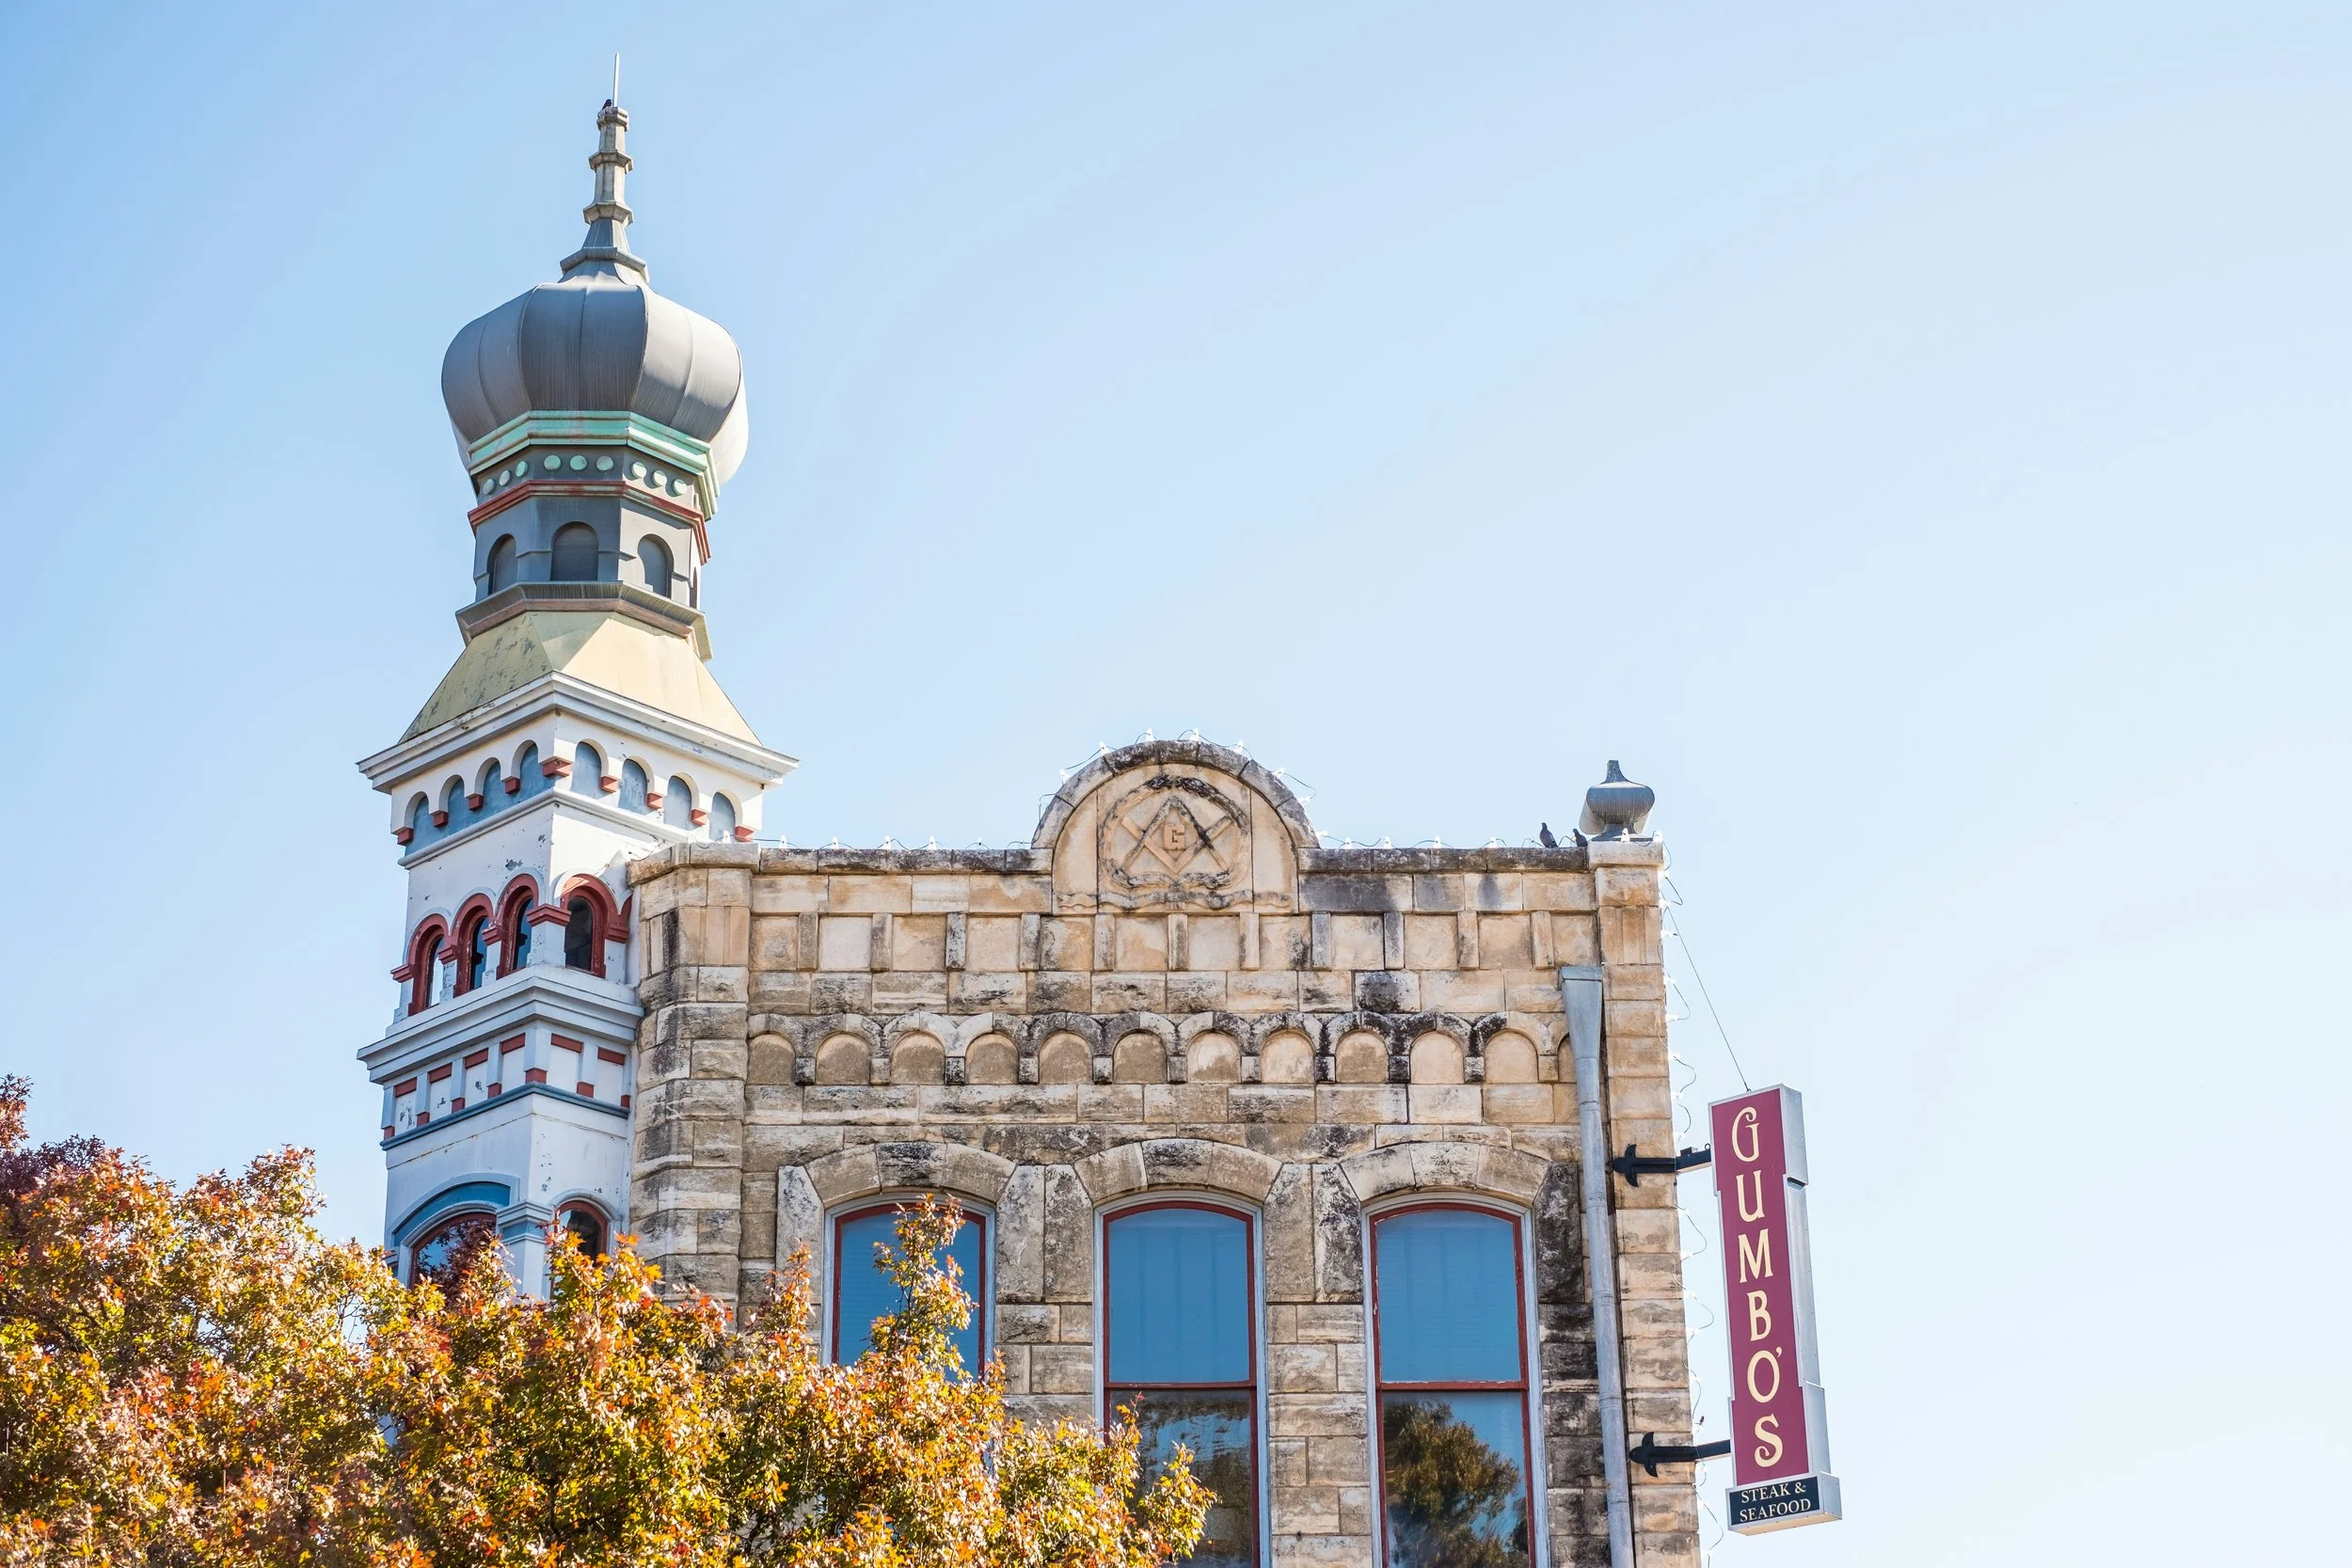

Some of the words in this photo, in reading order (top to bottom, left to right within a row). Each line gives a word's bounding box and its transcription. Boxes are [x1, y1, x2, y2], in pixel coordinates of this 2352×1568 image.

[1163, 822, 1185, 850] G
[1731, 1106, 1784, 1468] GUMBO'S
[1740, 1482, 1791, 1504] STEAK
[1794, 1481, 1806, 1494] &
[1740, 1497, 1811, 1522] SEAFOOD
